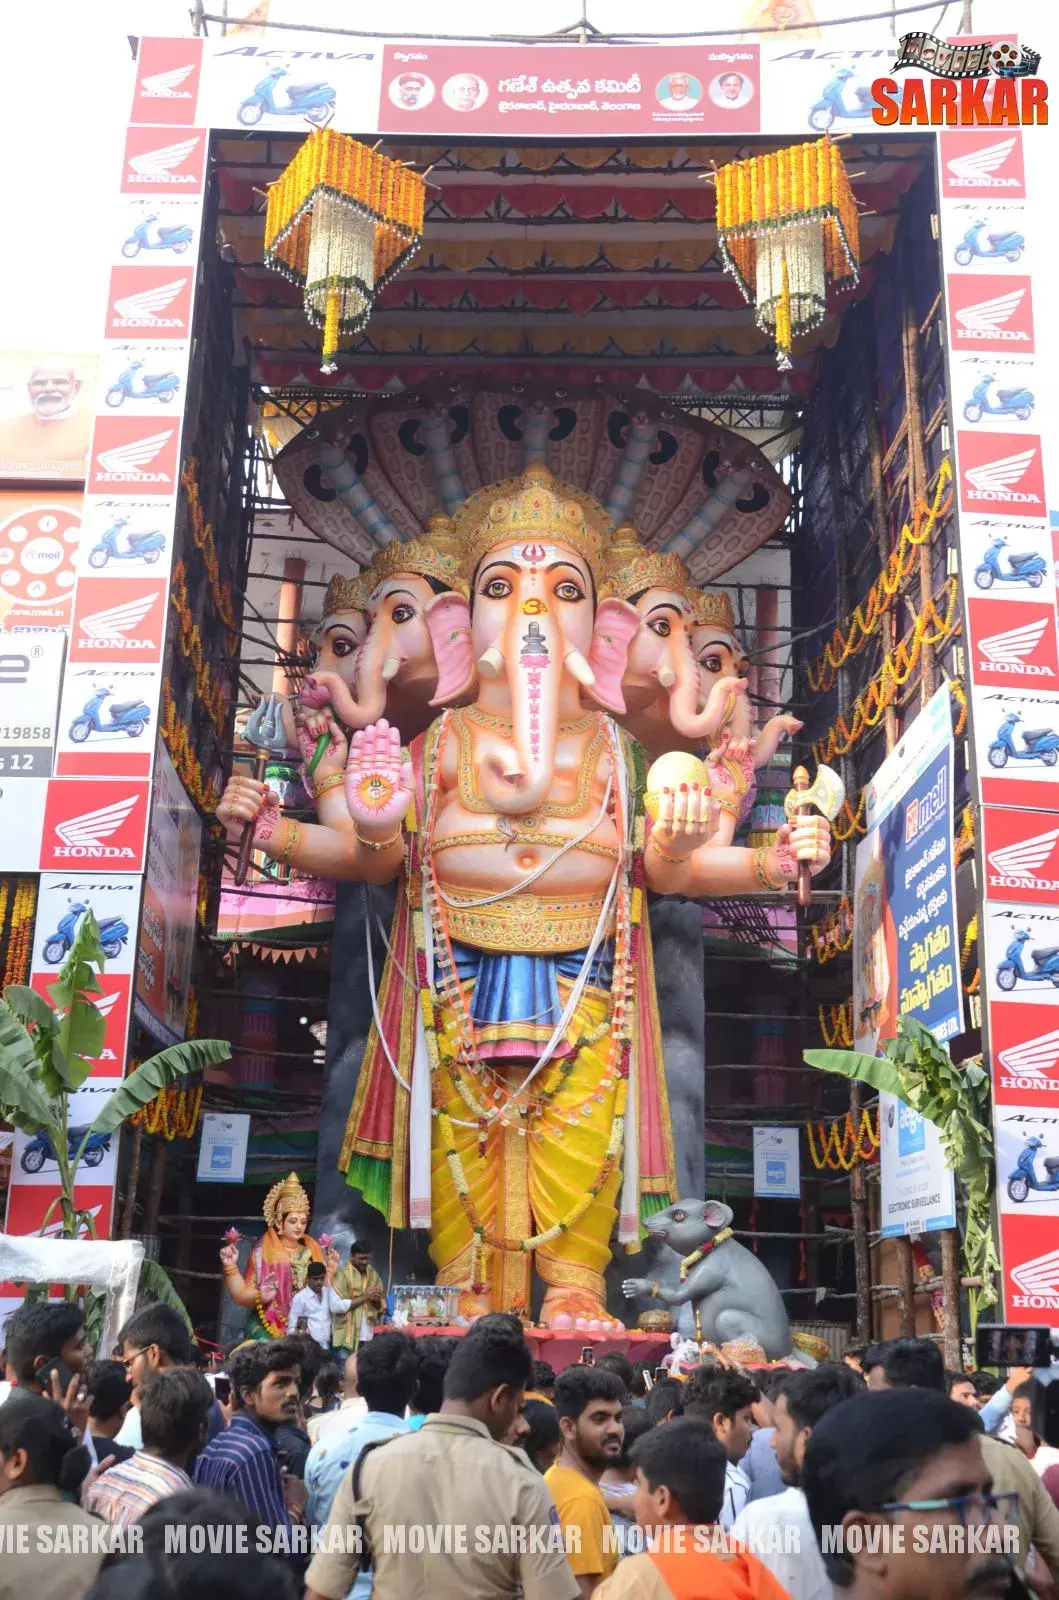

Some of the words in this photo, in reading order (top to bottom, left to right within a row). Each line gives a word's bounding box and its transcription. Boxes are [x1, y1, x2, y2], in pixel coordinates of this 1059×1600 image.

[213, 46, 375, 61] ACTIVA
[140, 91, 192, 99] HONDA
[127, 174, 198, 183] HONDA
[948, 178, 1022, 187] HONDA
[112, 318, 186, 328] HONDA
[956, 329, 1032, 341] HONDA
[95, 472, 170, 482] HONDA
[967, 489, 1042, 504] HONDA
[969, 519, 1046, 530] ACTIVA
[77, 638, 157, 649] HONDA
[73, 669, 155, 677] ACTIVA
[978, 660, 1056, 677] HONDA
[0, 726, 51, 740] 19858
[10, 754, 34, 770] 12
[52, 847, 136, 858] HONDA
[47, 882, 134, 890] ACTIVA
[990, 911, 1059, 921] ACTIV
[1000, 1076, 1059, 1091] HOND
[1002, 1114, 1059, 1124] ACTI
[1011, 1295, 1059, 1309] HON
